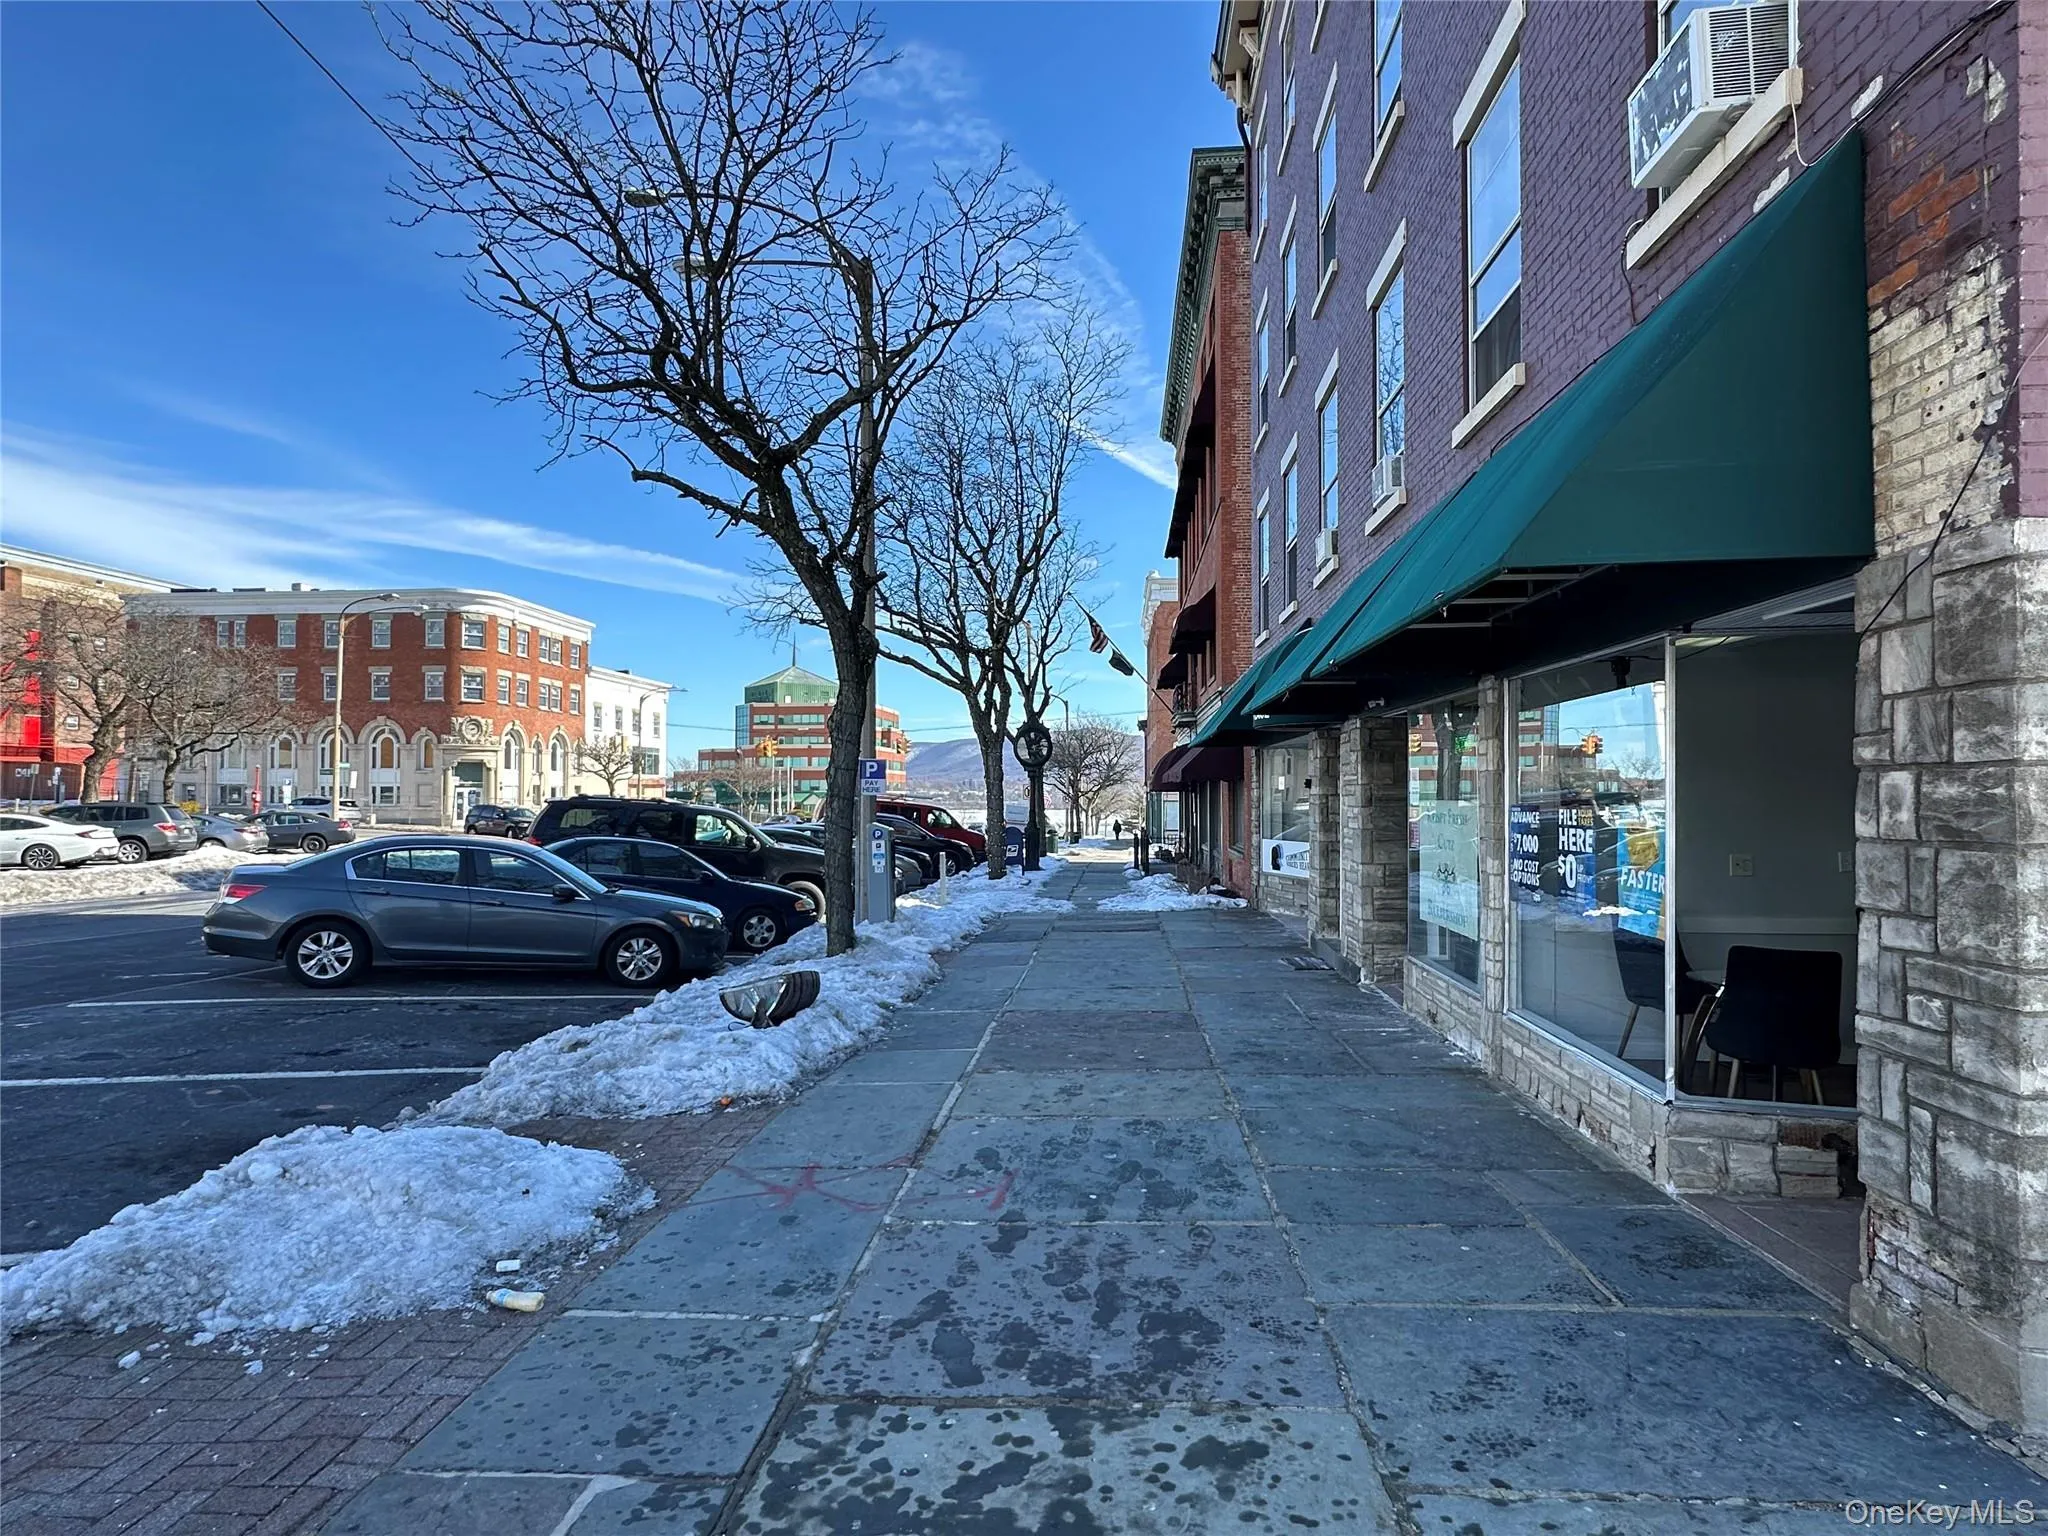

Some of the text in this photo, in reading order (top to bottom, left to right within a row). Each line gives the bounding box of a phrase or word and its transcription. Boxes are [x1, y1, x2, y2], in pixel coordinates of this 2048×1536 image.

[865, 761, 878, 778] P
[1511, 811, 1540, 823] ADVANCE
[1558, 808, 1577, 826] FILE
[1513, 833, 1539, 854] $7,000
[1558, 827, 1594, 853] HERE
[1513, 858, 1523, 870] NO
[1524, 860, 1540, 873] COST
[1558, 853, 1577, 889] $0
[1513, 871, 1540, 886] OPTIONS
[1620, 866, 1665, 894] FASTER
